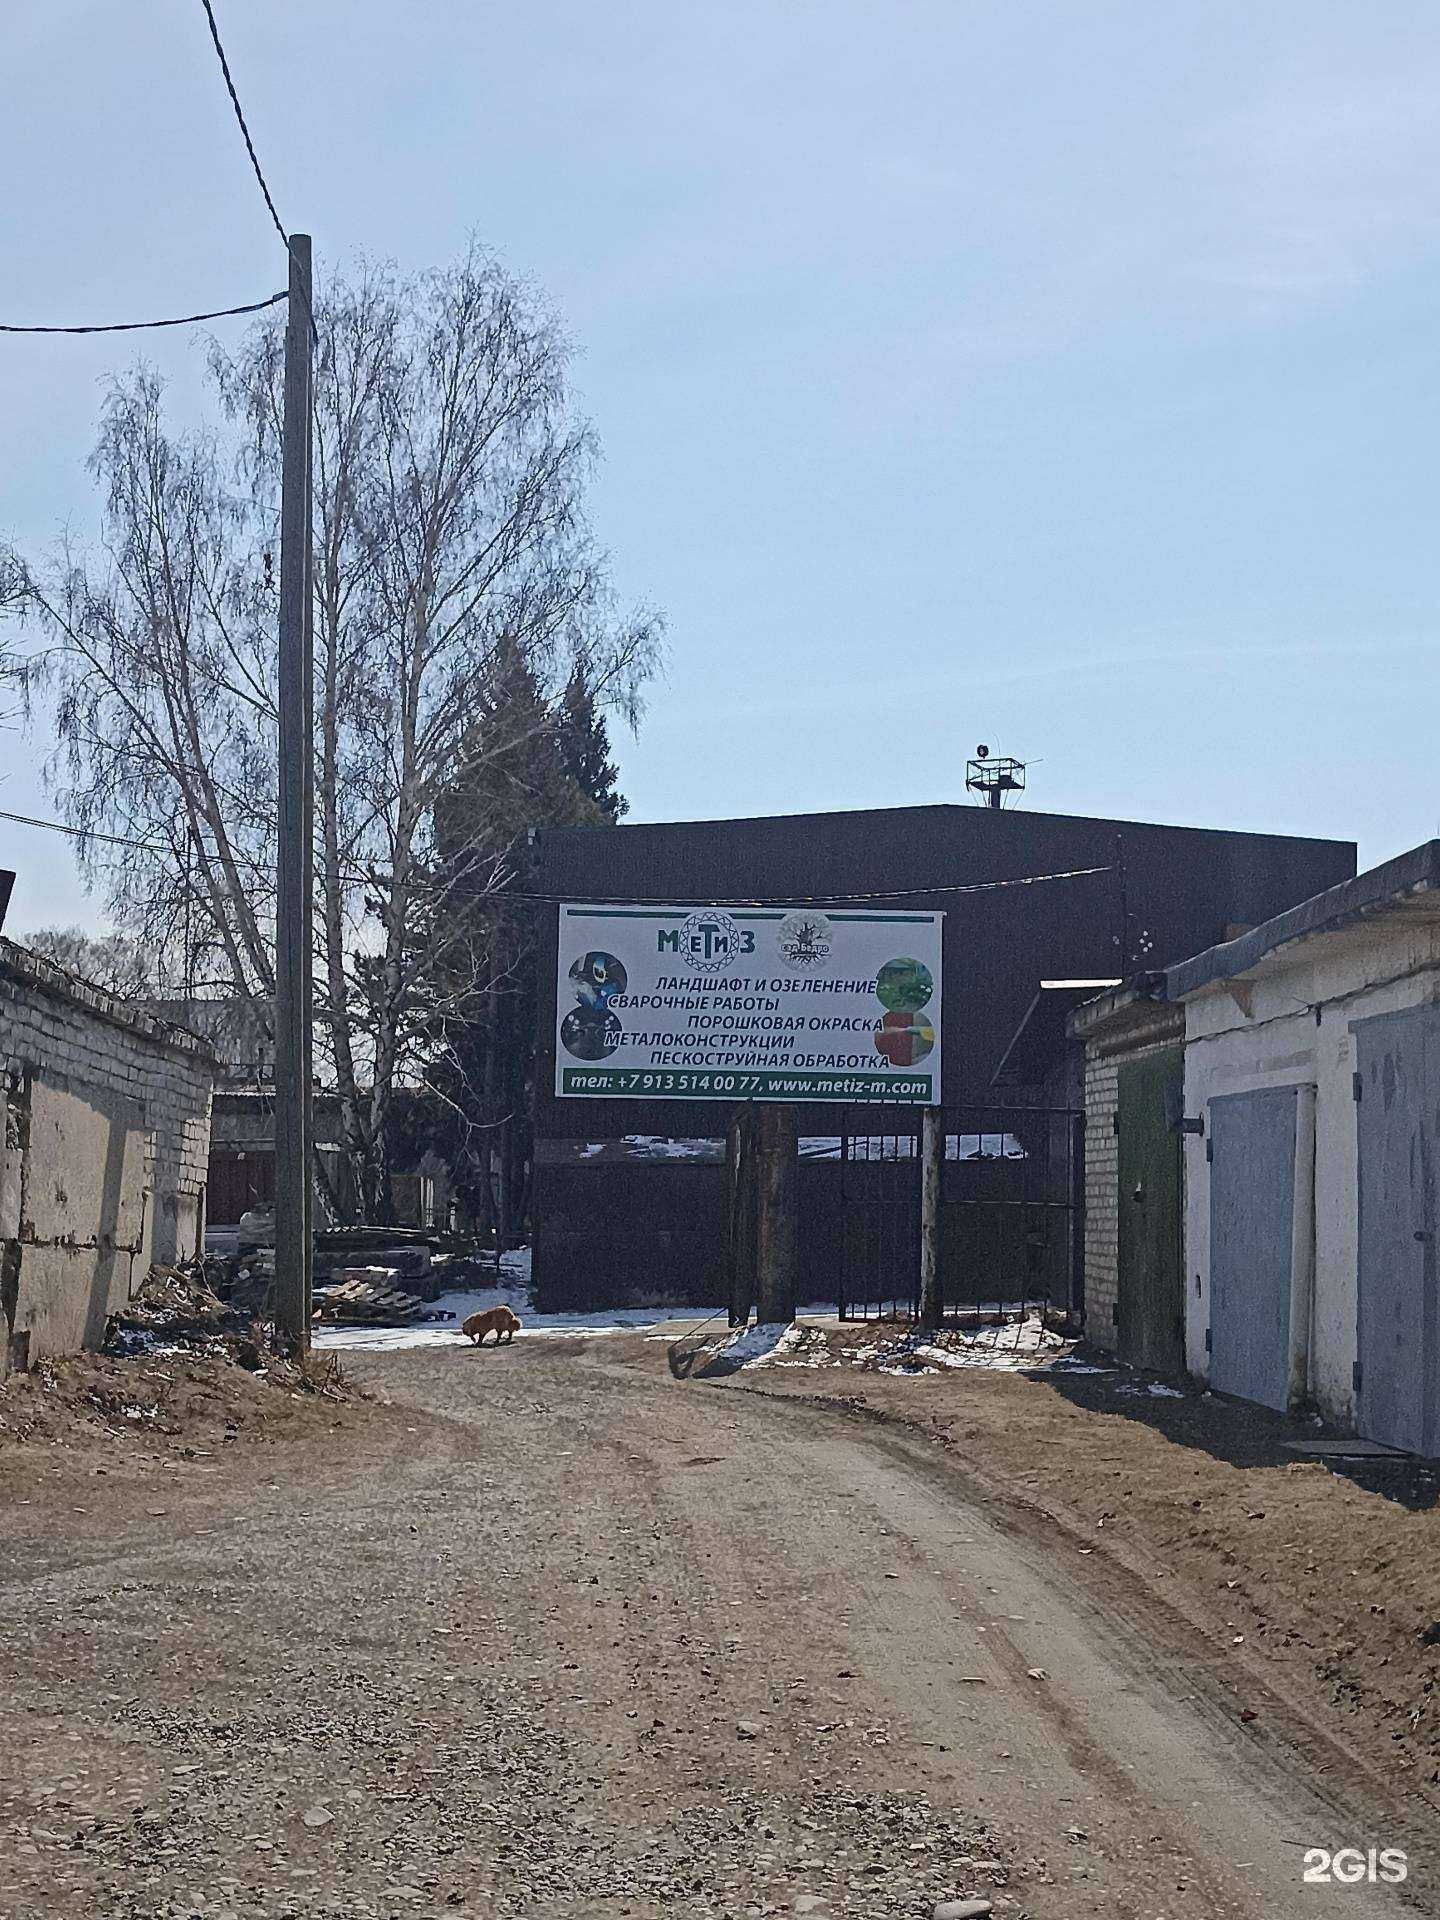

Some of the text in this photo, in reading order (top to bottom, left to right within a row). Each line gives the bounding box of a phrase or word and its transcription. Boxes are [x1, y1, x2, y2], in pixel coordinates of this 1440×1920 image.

[655, 977, 877, 994] ЛАНДШАФТ И ОЗЕЛЕНЕНИЕ
[607, 994, 780, 1011] СВАРОЧНЫЕ РАБОТЫ
[687, 1015, 884, 1032] ПОРОШКОВАЯ ОКРАСКА
[605, 1031, 795, 1050] МЕТАЛОКОНСТРУКЦИИ
[650, 1050, 889, 1069] ПЕСКОСТРУЙНАЯ ОБРАБОТКА
[570, 1074, 928, 1095] тел: +7 913 514 00 77, www.metiz-m.com
